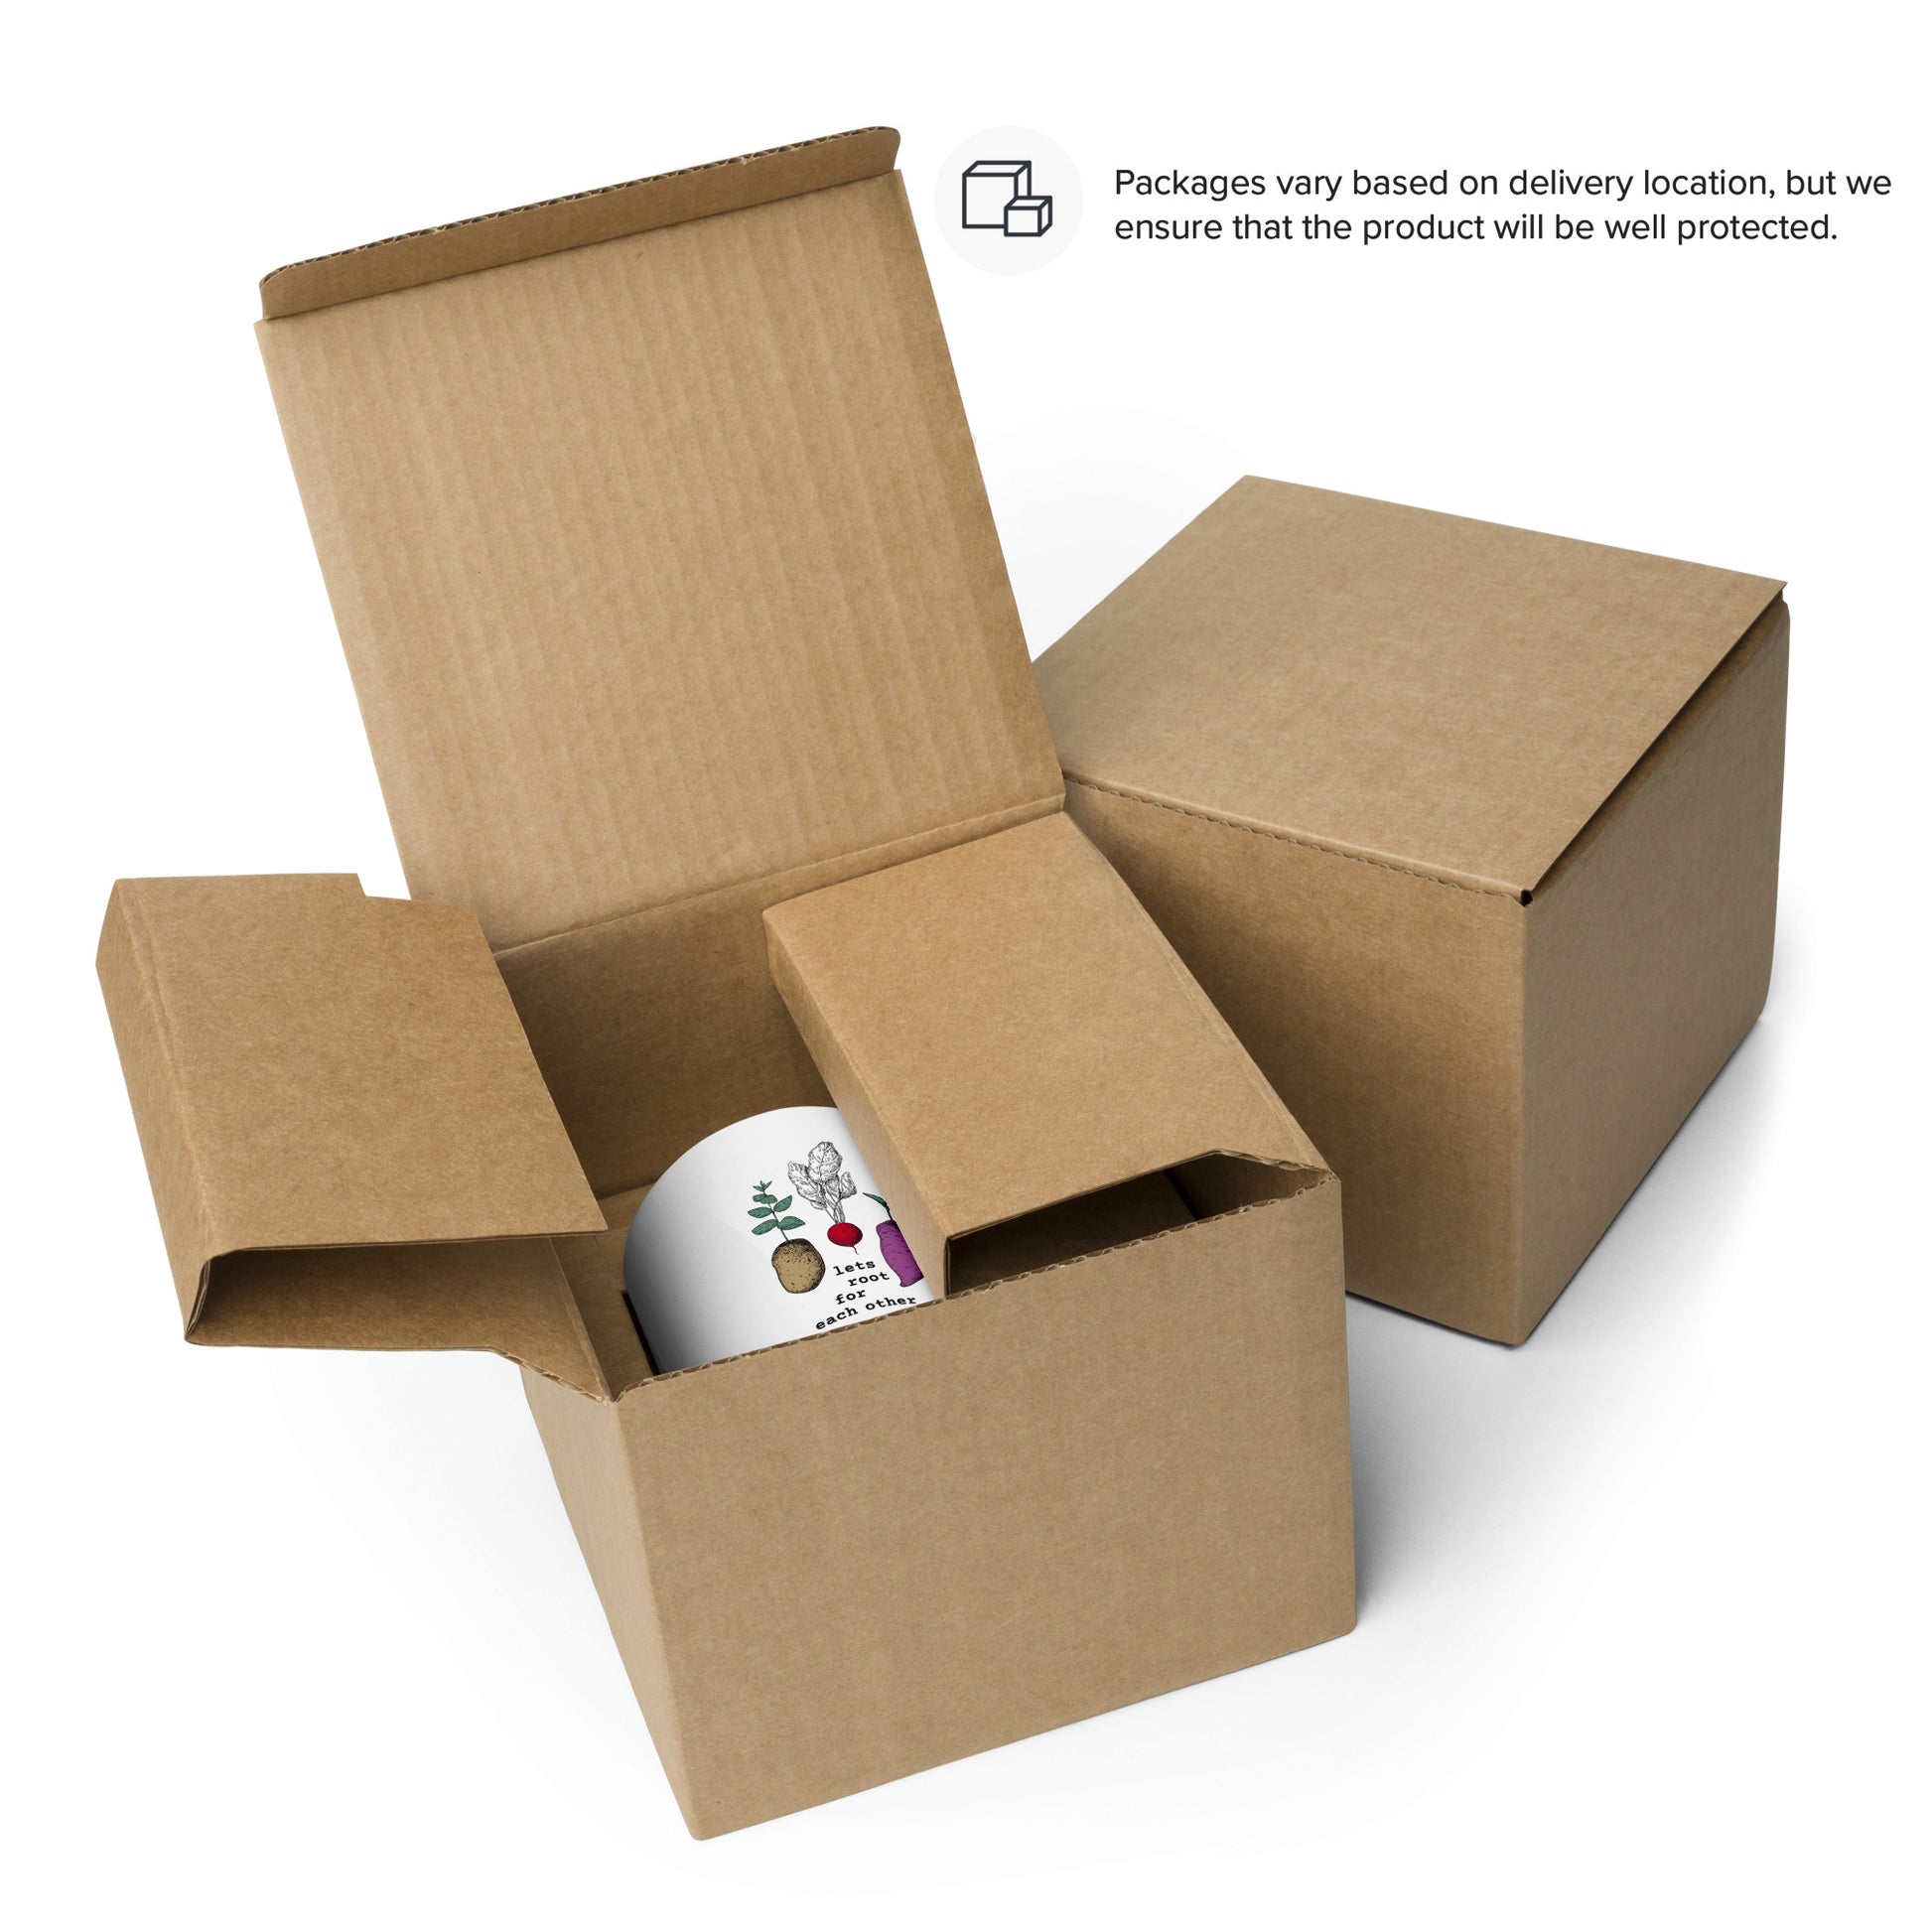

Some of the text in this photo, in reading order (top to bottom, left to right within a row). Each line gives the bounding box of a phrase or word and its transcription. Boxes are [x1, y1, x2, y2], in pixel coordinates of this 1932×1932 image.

[833, 1260, 876, 1276] lets
[847, 1272, 890, 1287] root
[835, 1289, 866, 1305] for
[815, 1296, 916, 1330] each other
